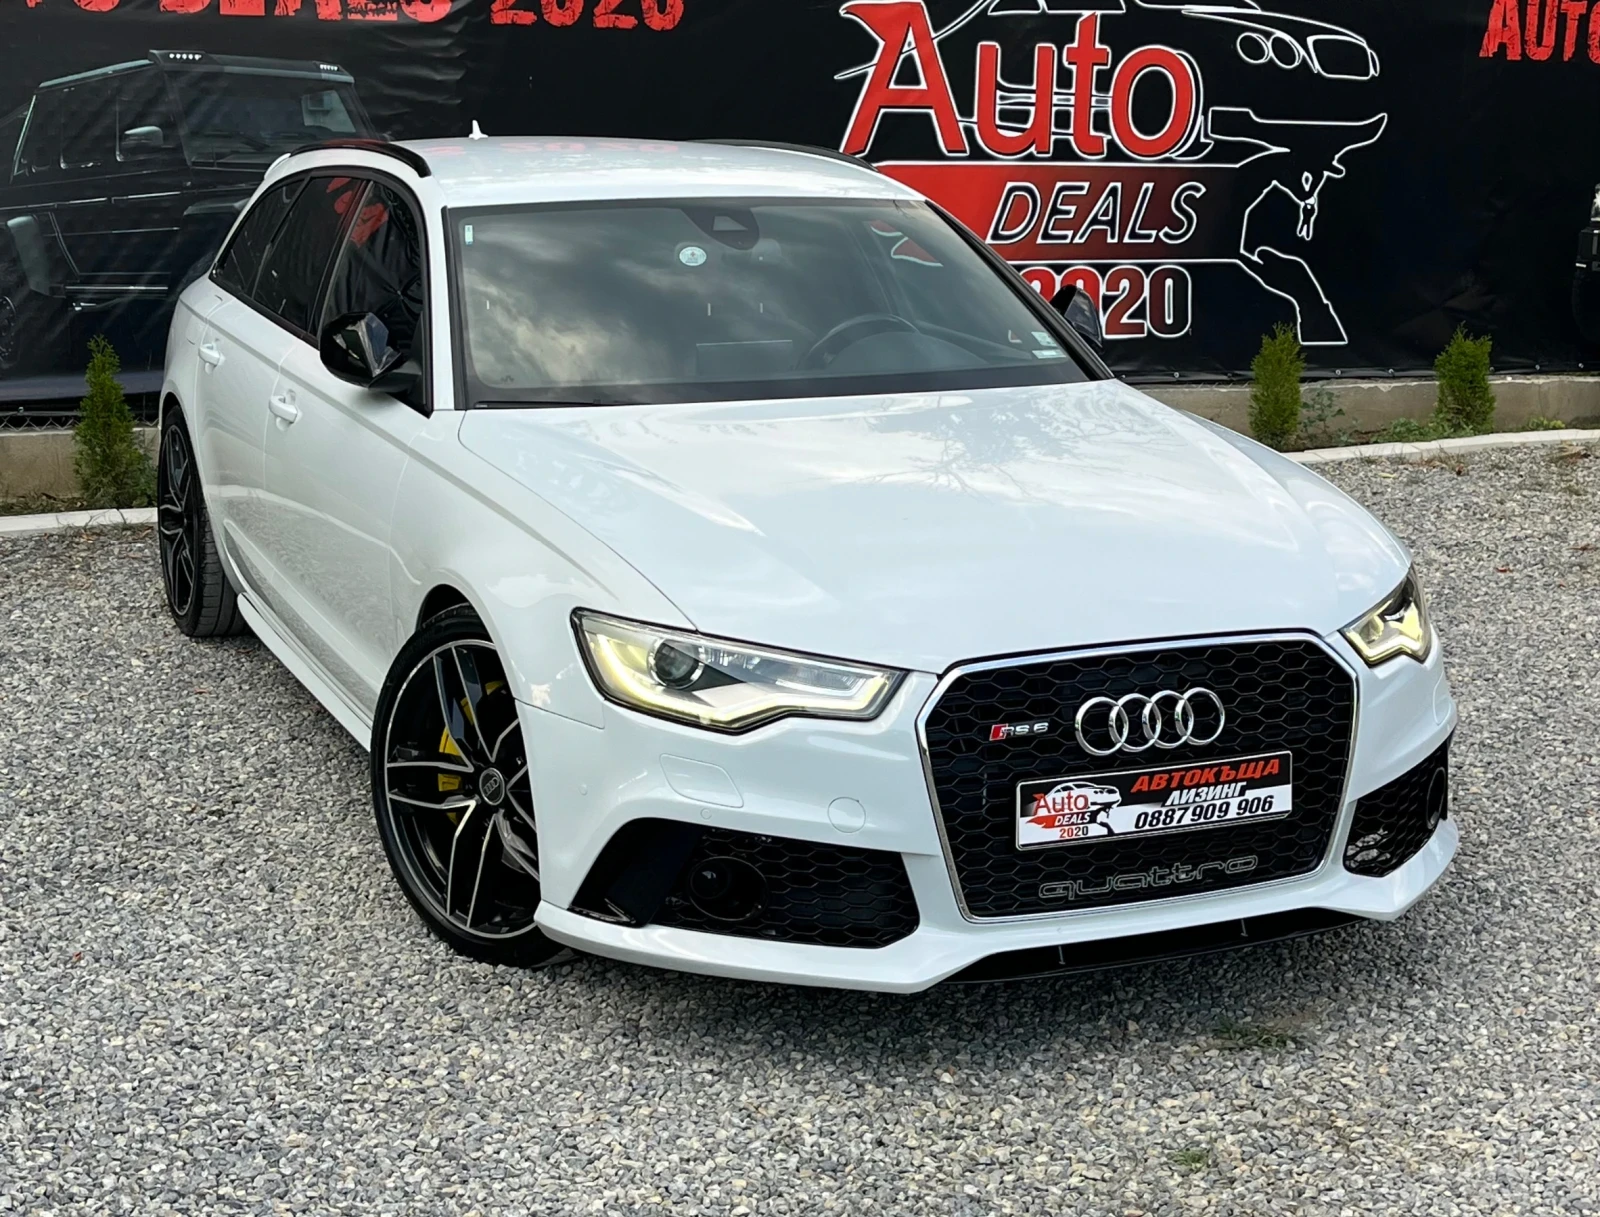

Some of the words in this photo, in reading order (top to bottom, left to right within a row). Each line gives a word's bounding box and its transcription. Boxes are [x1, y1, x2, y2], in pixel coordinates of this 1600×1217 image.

[841, 0, 1196, 157] Auto
[985, 181, 1207, 244] DEALS
[1131, 758, 1280, 793] АВТОКЪЩА
[1032, 790, 1089, 816] Auto
[1163, 781, 1247, 807] ЛИЗИНГ
[1236, 795, 1275, 816] 906
[1054, 812, 1091, 826] DEALS
[1059, 825, 1089, 839] 2020
[1038, 855, 1259, 900] quattro
